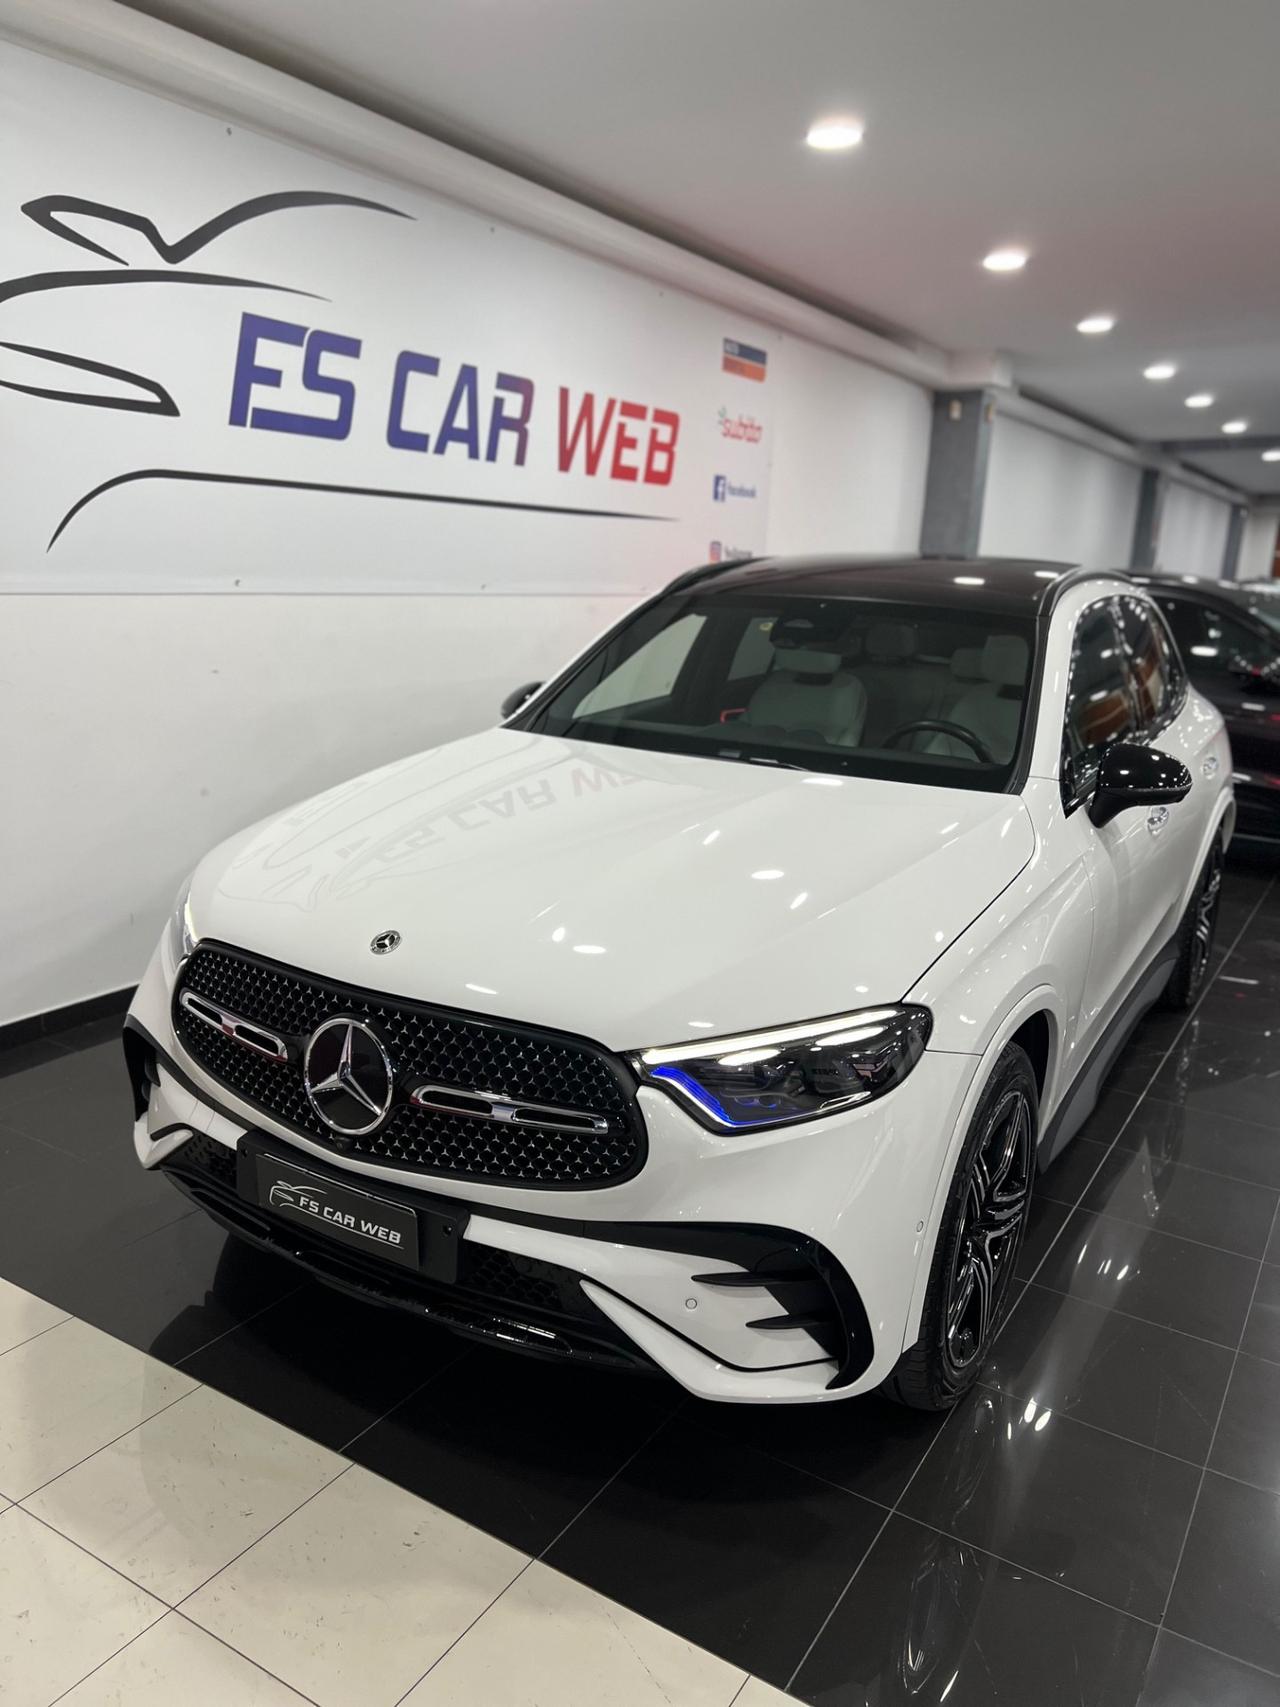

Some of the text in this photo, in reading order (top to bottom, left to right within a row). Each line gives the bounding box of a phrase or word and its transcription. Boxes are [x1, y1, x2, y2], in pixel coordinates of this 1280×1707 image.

[386, 350, 535, 467] CAR
[557, 386, 681, 486] WEB
[299, 1196, 402, 1244] FS CAR WEB
